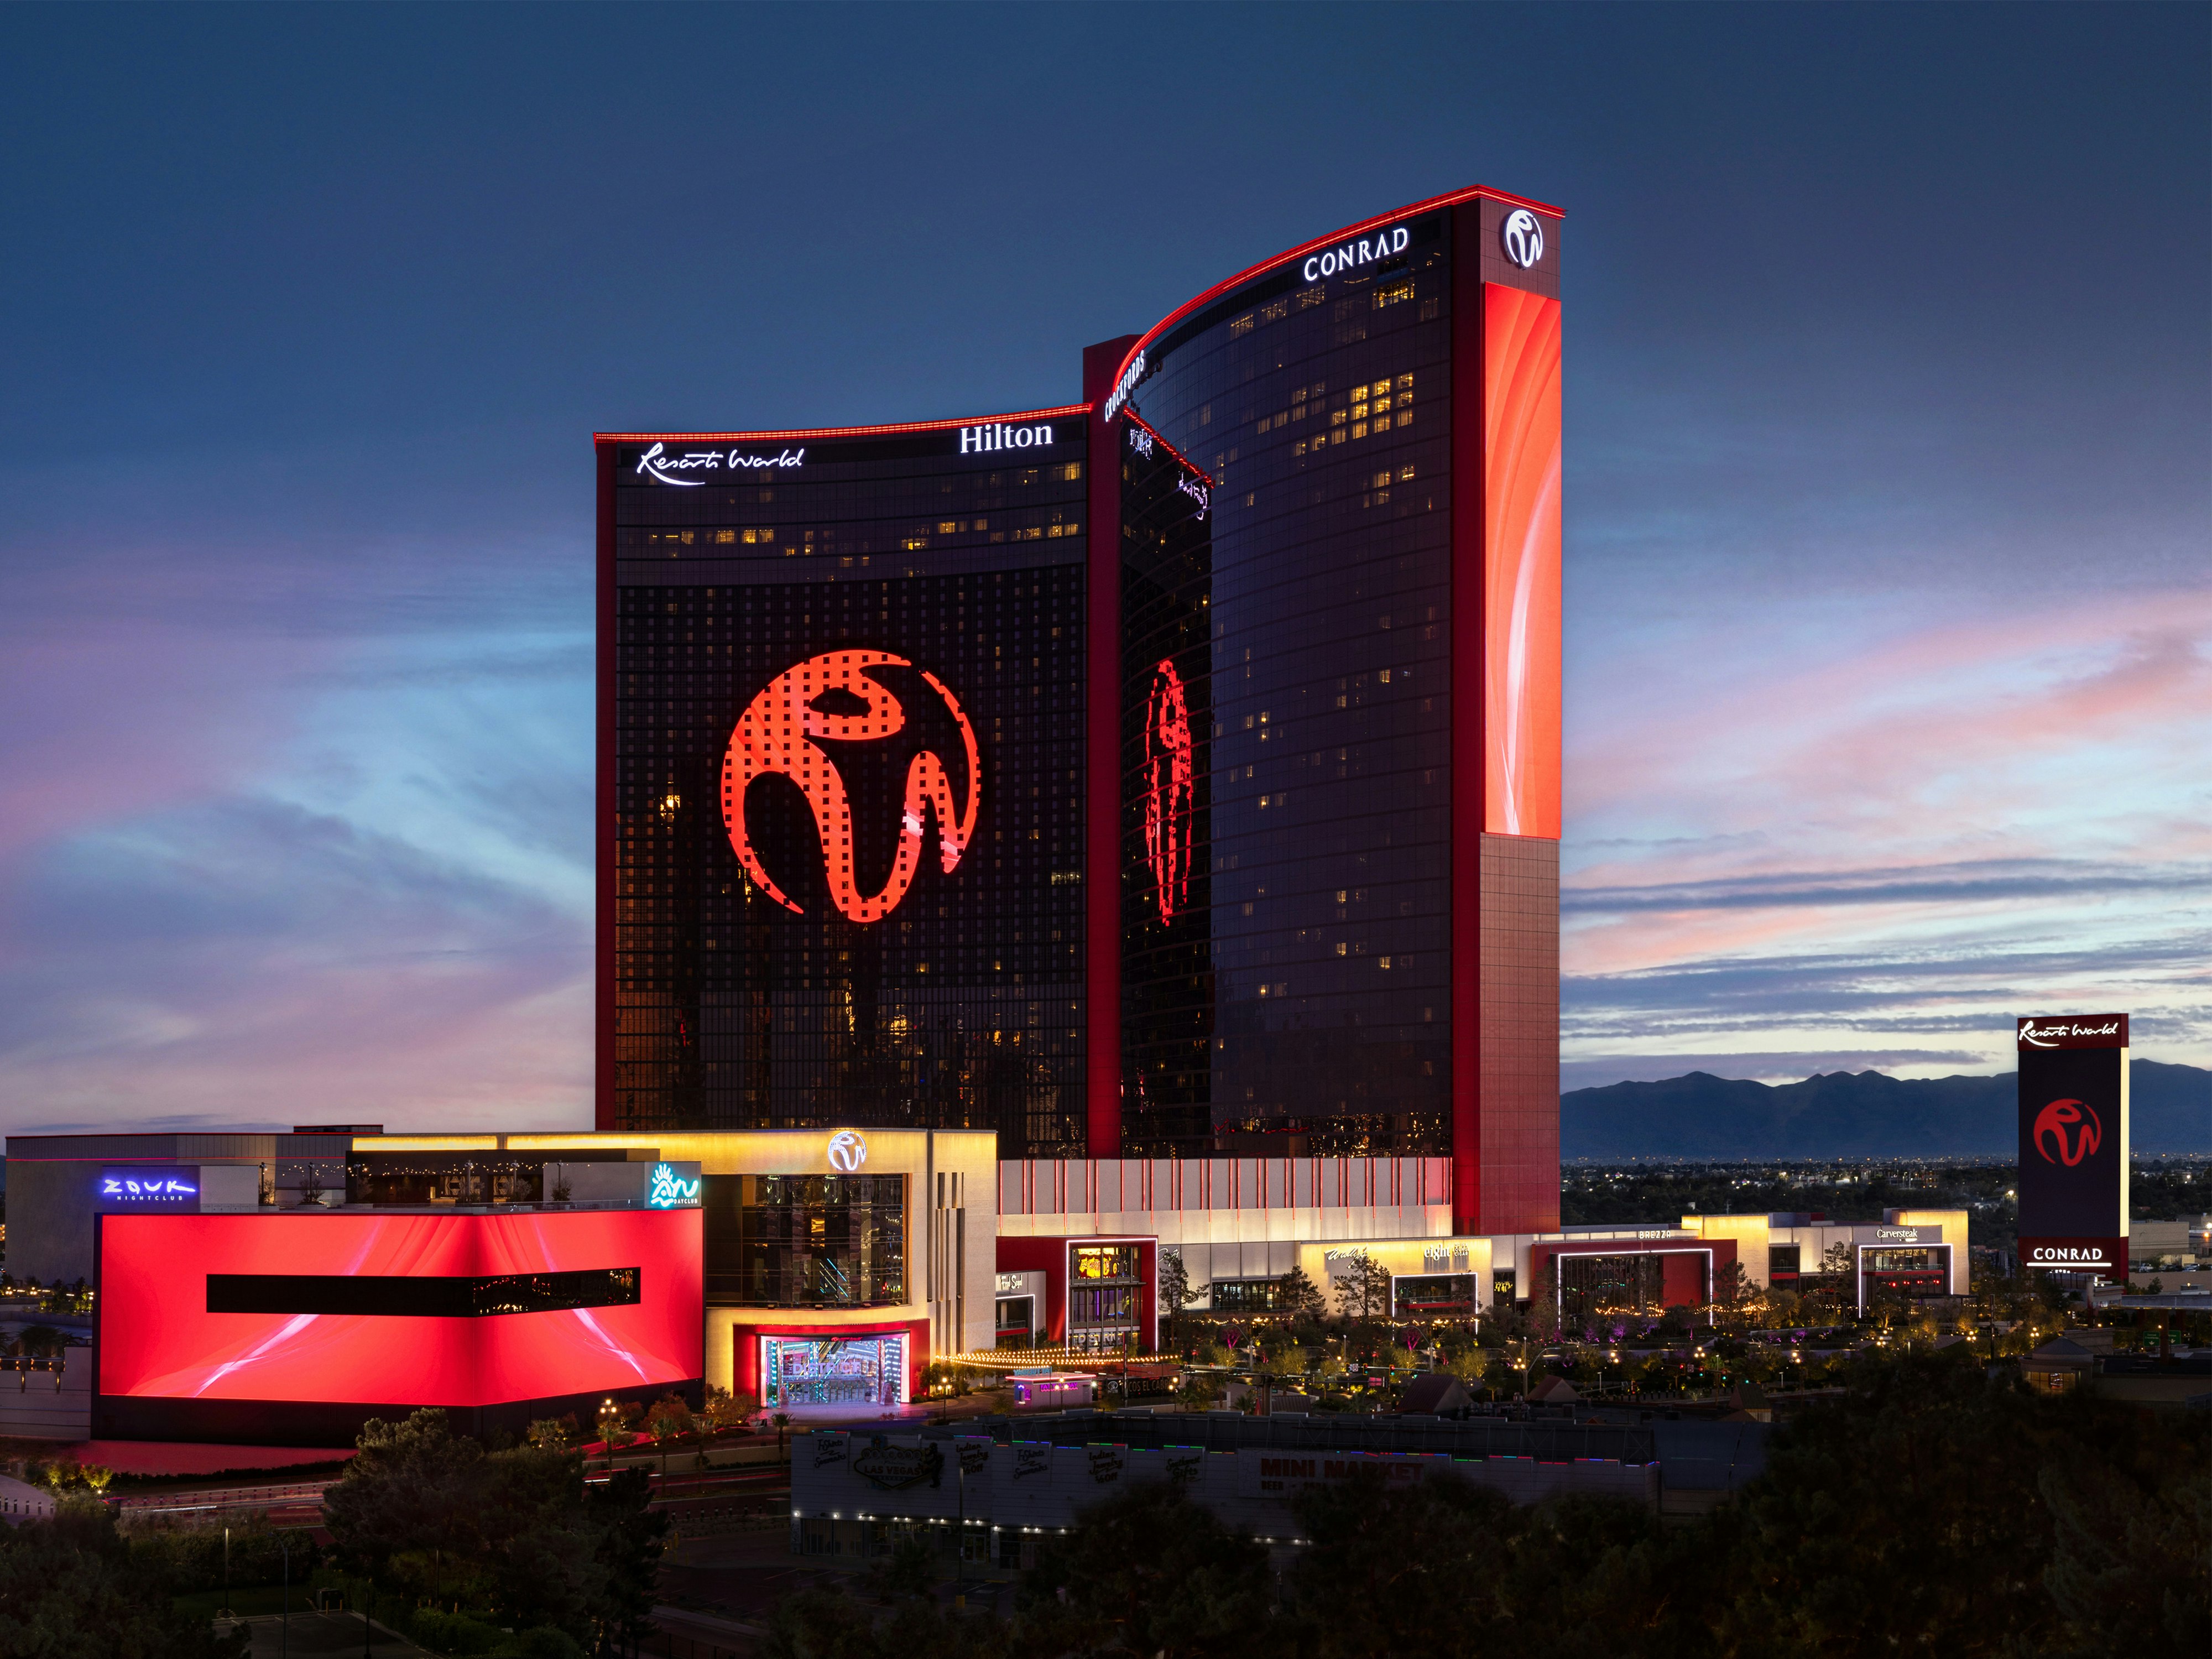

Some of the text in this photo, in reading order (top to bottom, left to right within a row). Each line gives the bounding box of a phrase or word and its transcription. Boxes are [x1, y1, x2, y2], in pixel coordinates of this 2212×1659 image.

[1304, 227, 1409, 281] CONRAD
[1105, 349, 1144, 422] CROCKFORDS
[961, 424, 1053, 453] Hilton
[637, 442, 805, 486] Resorts World
[2019, 1020, 2119, 1047] Resorts World
[1639, 1230, 1671, 1239] BREZZA
[1876, 1228, 1918, 1238] Carversteak
[1424, 1243, 1450, 1261] eight
[2033, 1248, 2103, 1260] CONRAD
[1001, 1274, 1022, 1290] Fred Segal
[793, 1361, 860, 1374] DISTRICT
[864, 1450, 920, 1459] WELCOME
[956, 1442, 982, 1452] Indian
[960, 1449, 989, 1463] Jewelry
[1089, 1451, 1116, 1460] Indian
[1166, 1455, 1201, 1472] Southwest
[864, 1465, 921, 1475] LAS VEGAS
[1089, 1458, 1123, 1475] Jewelry
[1261, 1458, 1425, 1480] MINI MARKET
[1172, 1466, 1198, 1484] Gifts
[1261, 1480, 1283, 1490] BEER
